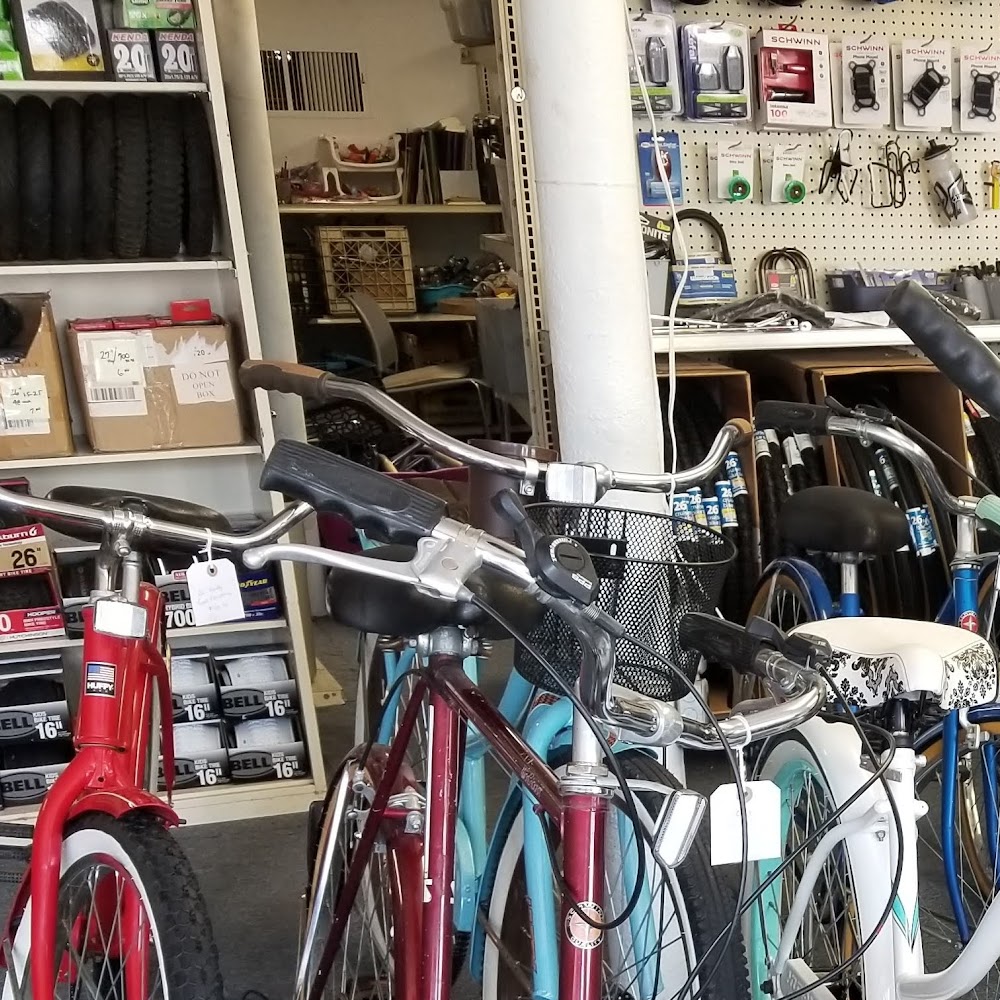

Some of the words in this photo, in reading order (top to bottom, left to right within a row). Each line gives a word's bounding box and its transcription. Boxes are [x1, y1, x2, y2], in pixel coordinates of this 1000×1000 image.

[112, 33, 149, 41] KENDA
[159, 33, 194, 41] KENDA
[771, 36, 820, 46] SCHWINN
[770, 109, 788, 118] 100
[182, 373, 197, 381] DO
[199, 371, 220, 379] NOT
[196, 390, 215, 398] BOX
[87, 682, 114, 691] HUFFY
[224, 695, 260, 708] BELL
[230, 758, 271, 771] BELL
[2, 778, 45, 793] BELL
